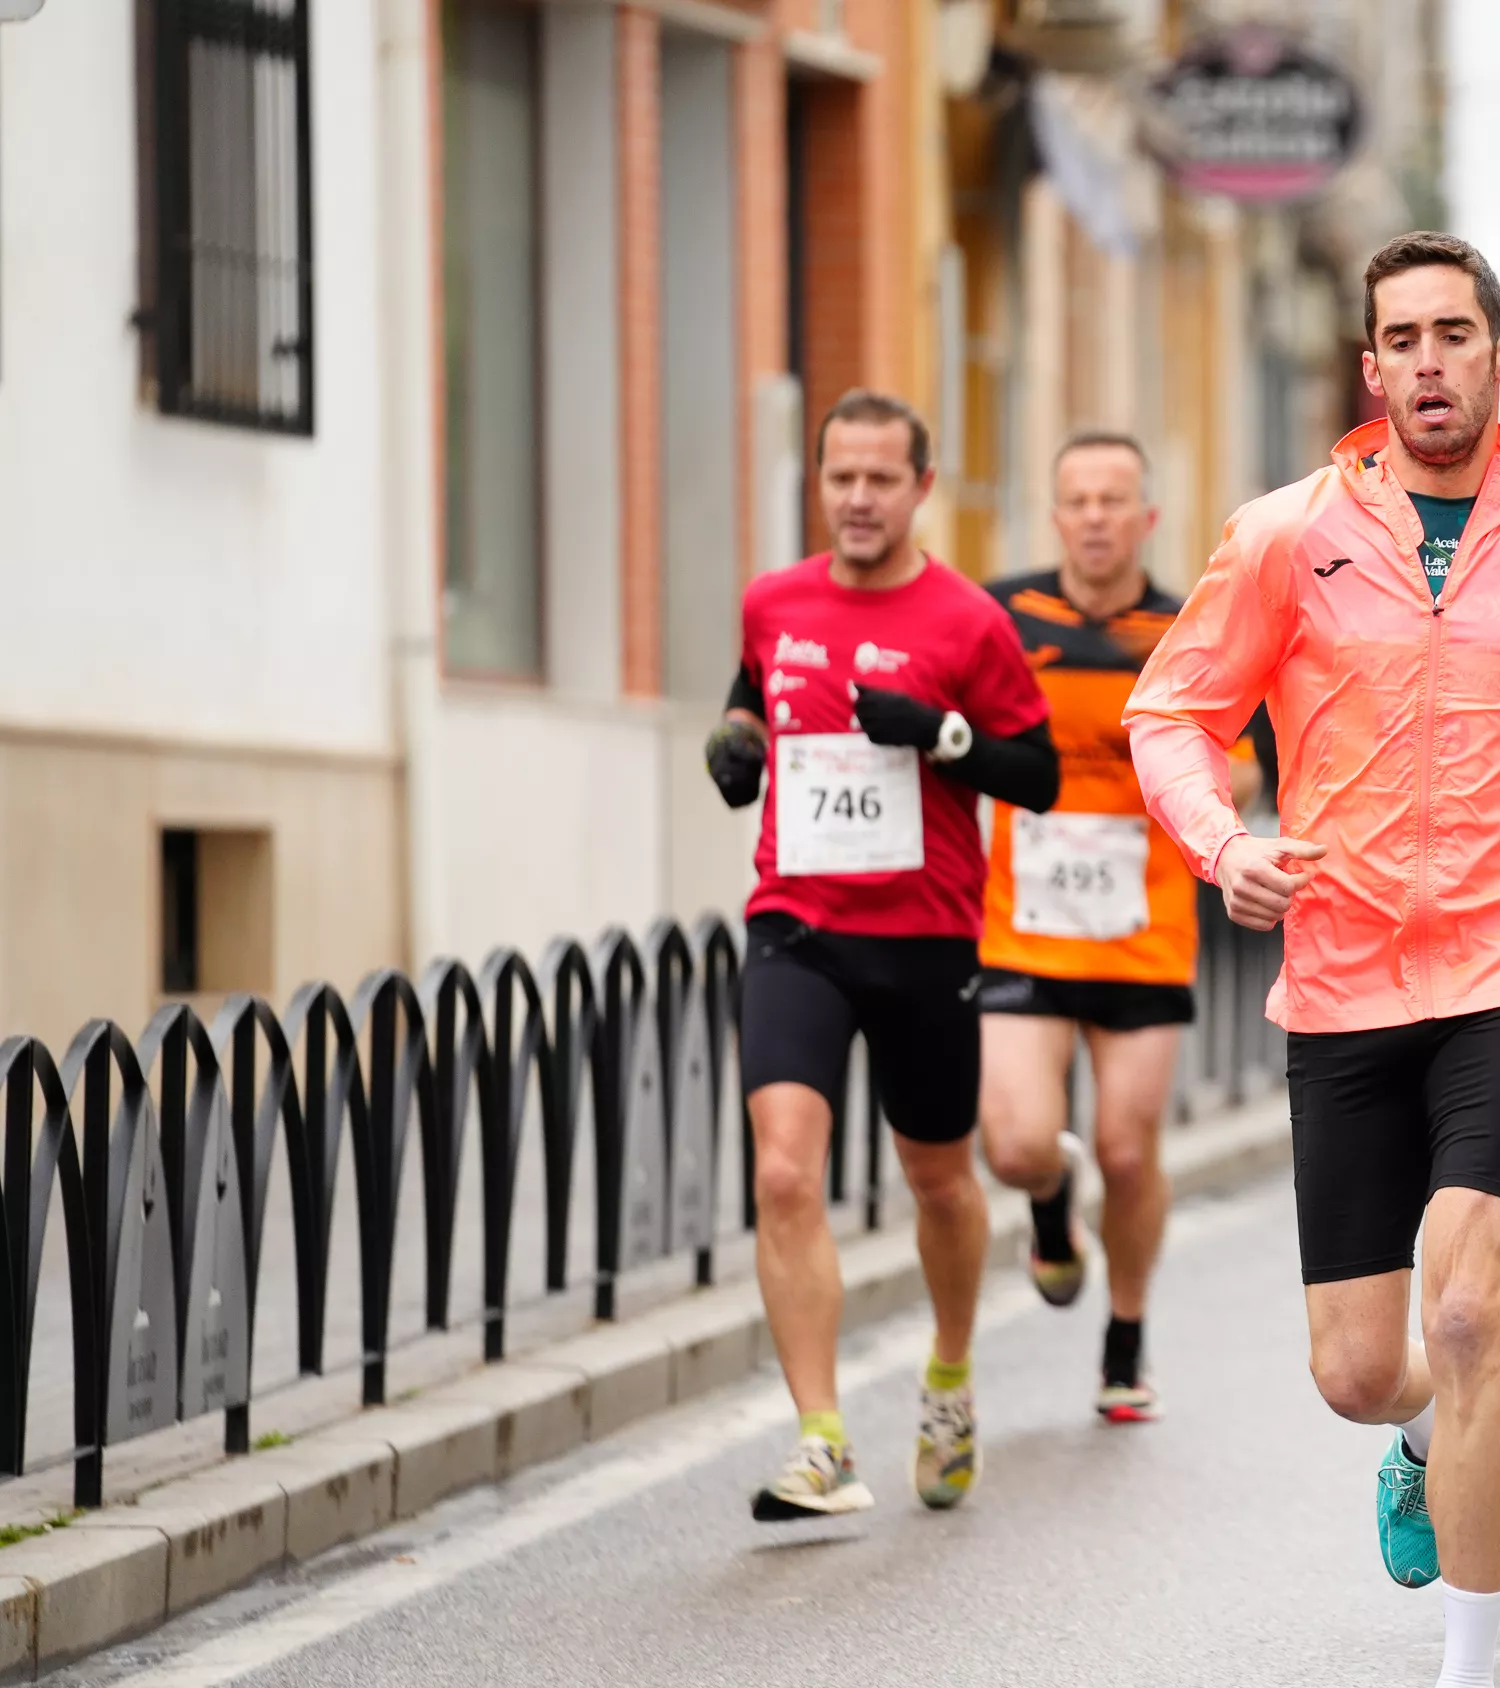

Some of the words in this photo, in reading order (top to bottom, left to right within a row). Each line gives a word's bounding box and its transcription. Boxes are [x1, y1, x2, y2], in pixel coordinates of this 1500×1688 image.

[1424, 566, 1450, 576] Vald
[1425, 555, 1446, 566] Las
[809, 785, 882, 822] 746
[1050, 861, 1115, 895] 495
